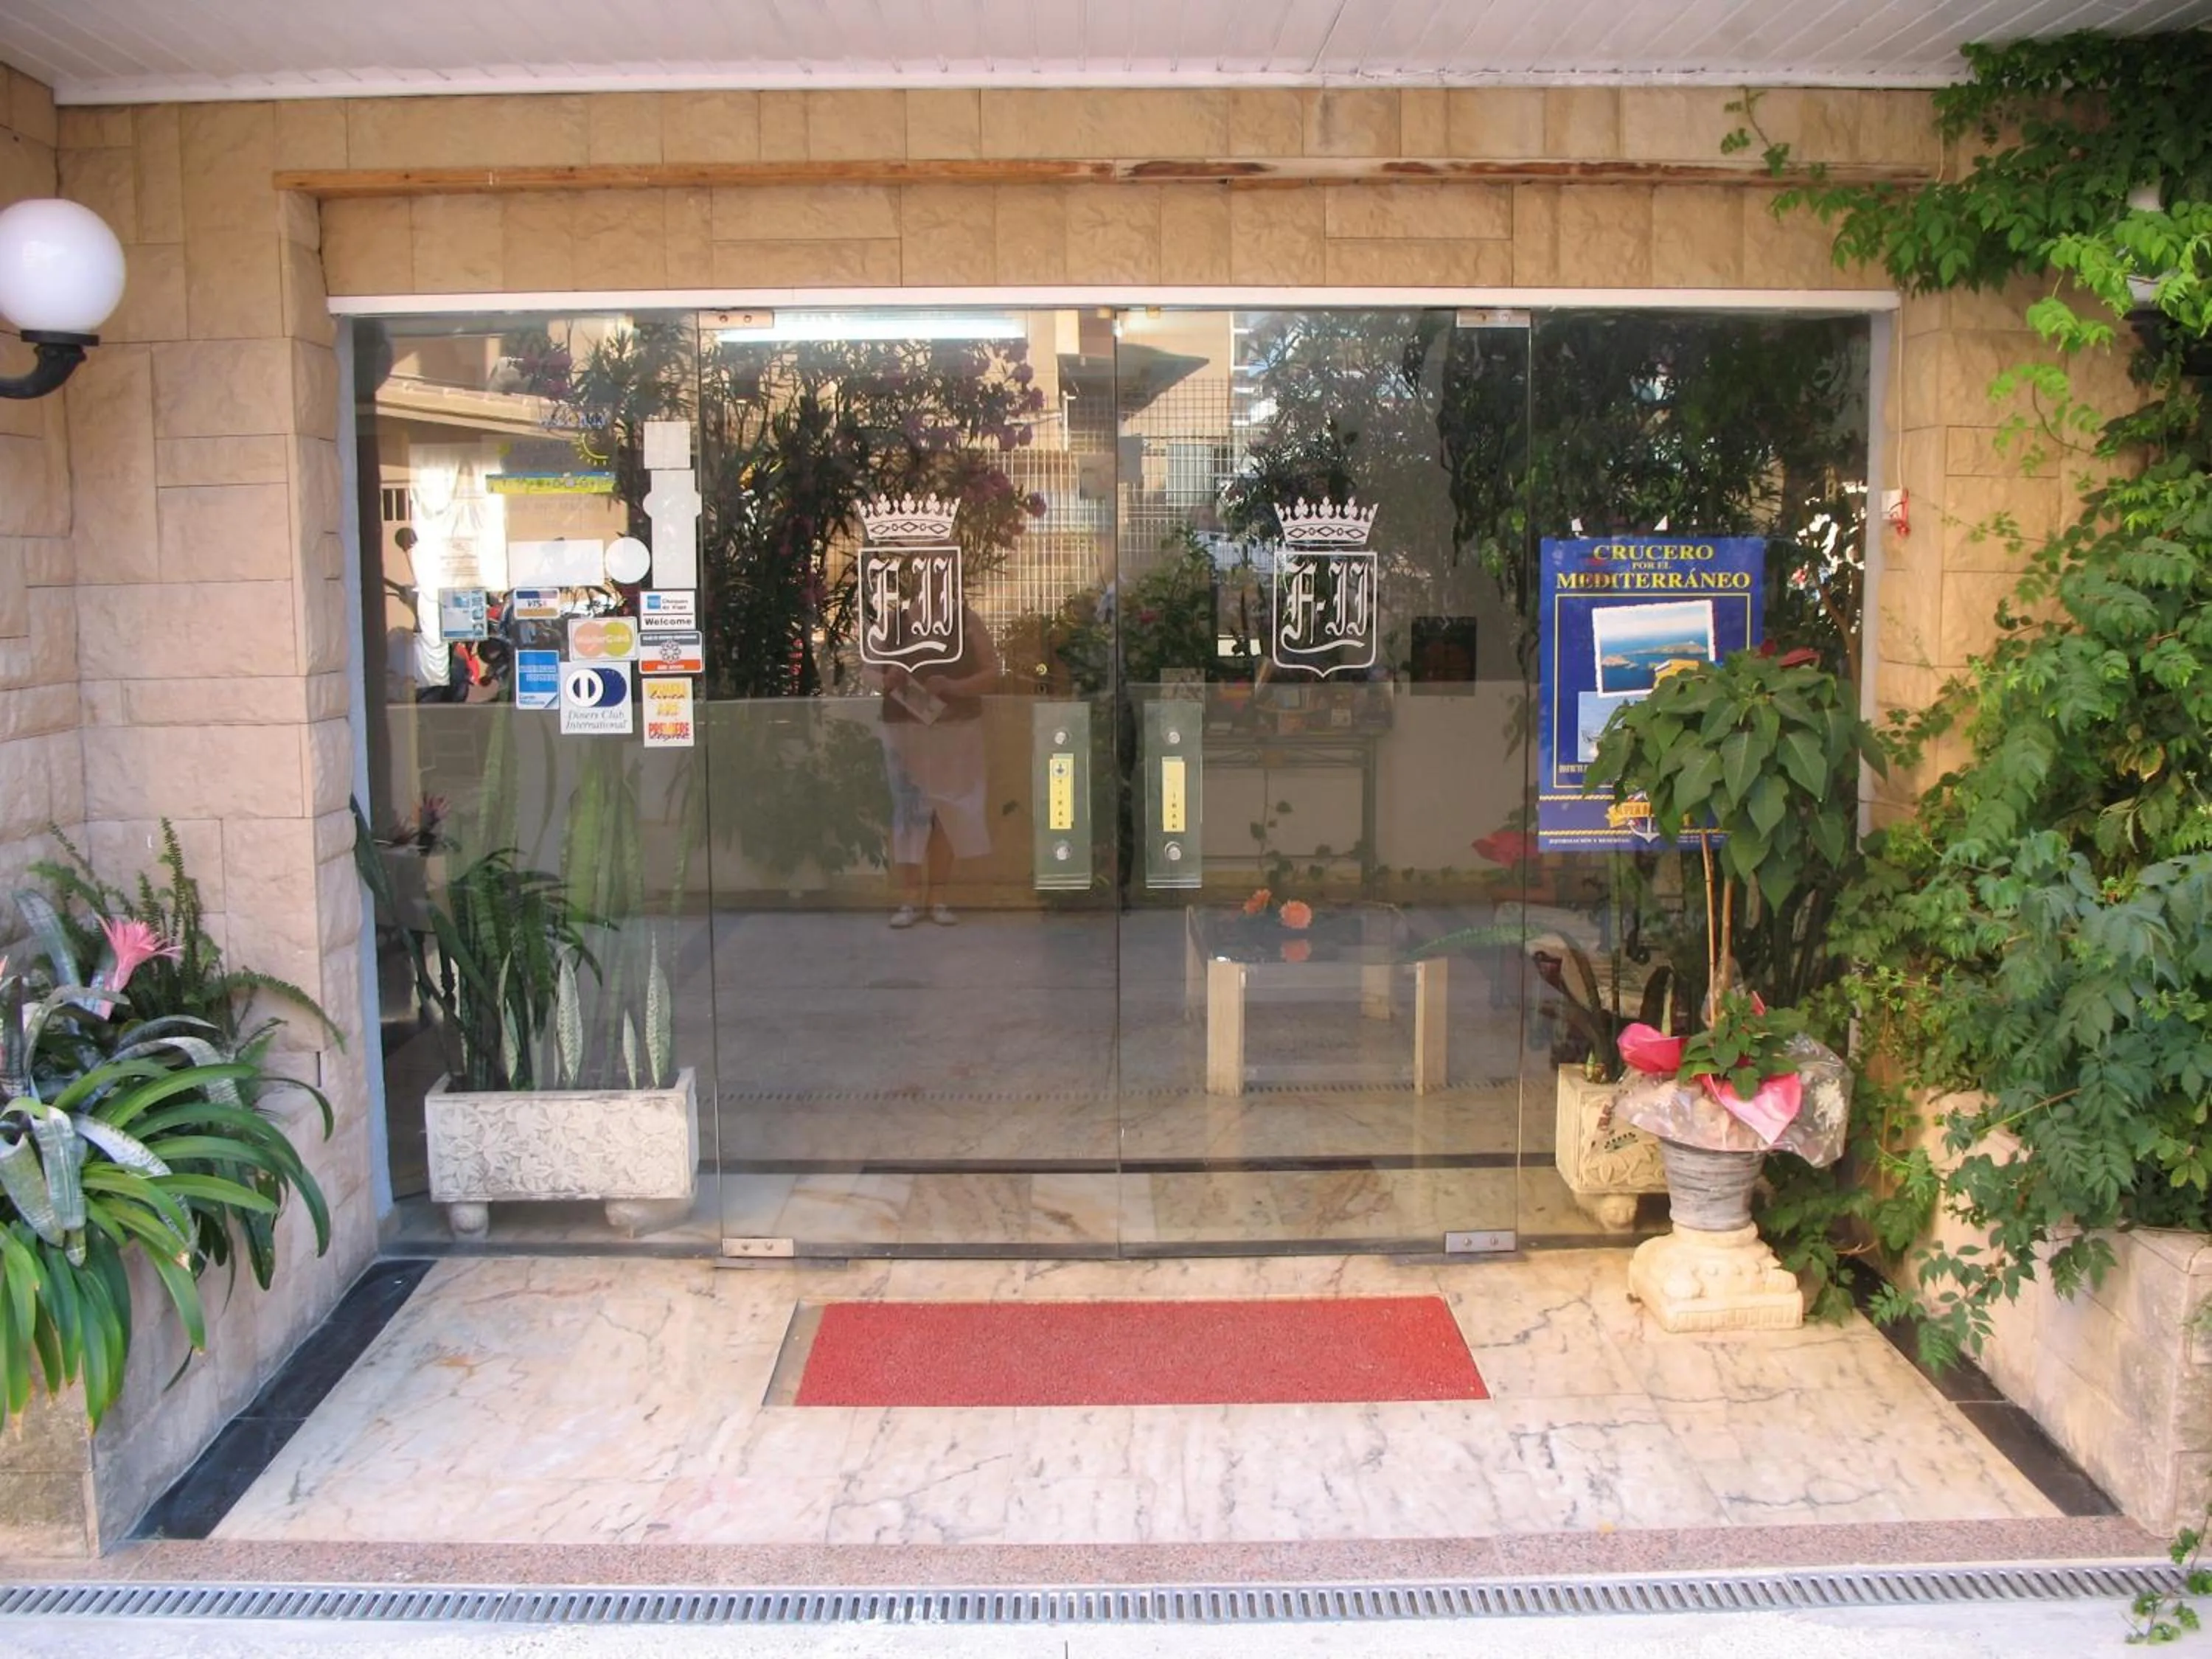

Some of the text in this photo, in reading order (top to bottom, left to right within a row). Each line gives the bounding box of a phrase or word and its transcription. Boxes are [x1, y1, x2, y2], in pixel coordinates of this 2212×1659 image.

[1593, 545, 1714, 560] CRUCERO
[1632, 561, 1672, 570] POR EL
[1557, 567, 1751, 589] MEDITERRÁNEO
[644, 618, 692, 626] Welcome
[568, 710, 625, 719] Diners Club
[566, 720, 628, 729] International
